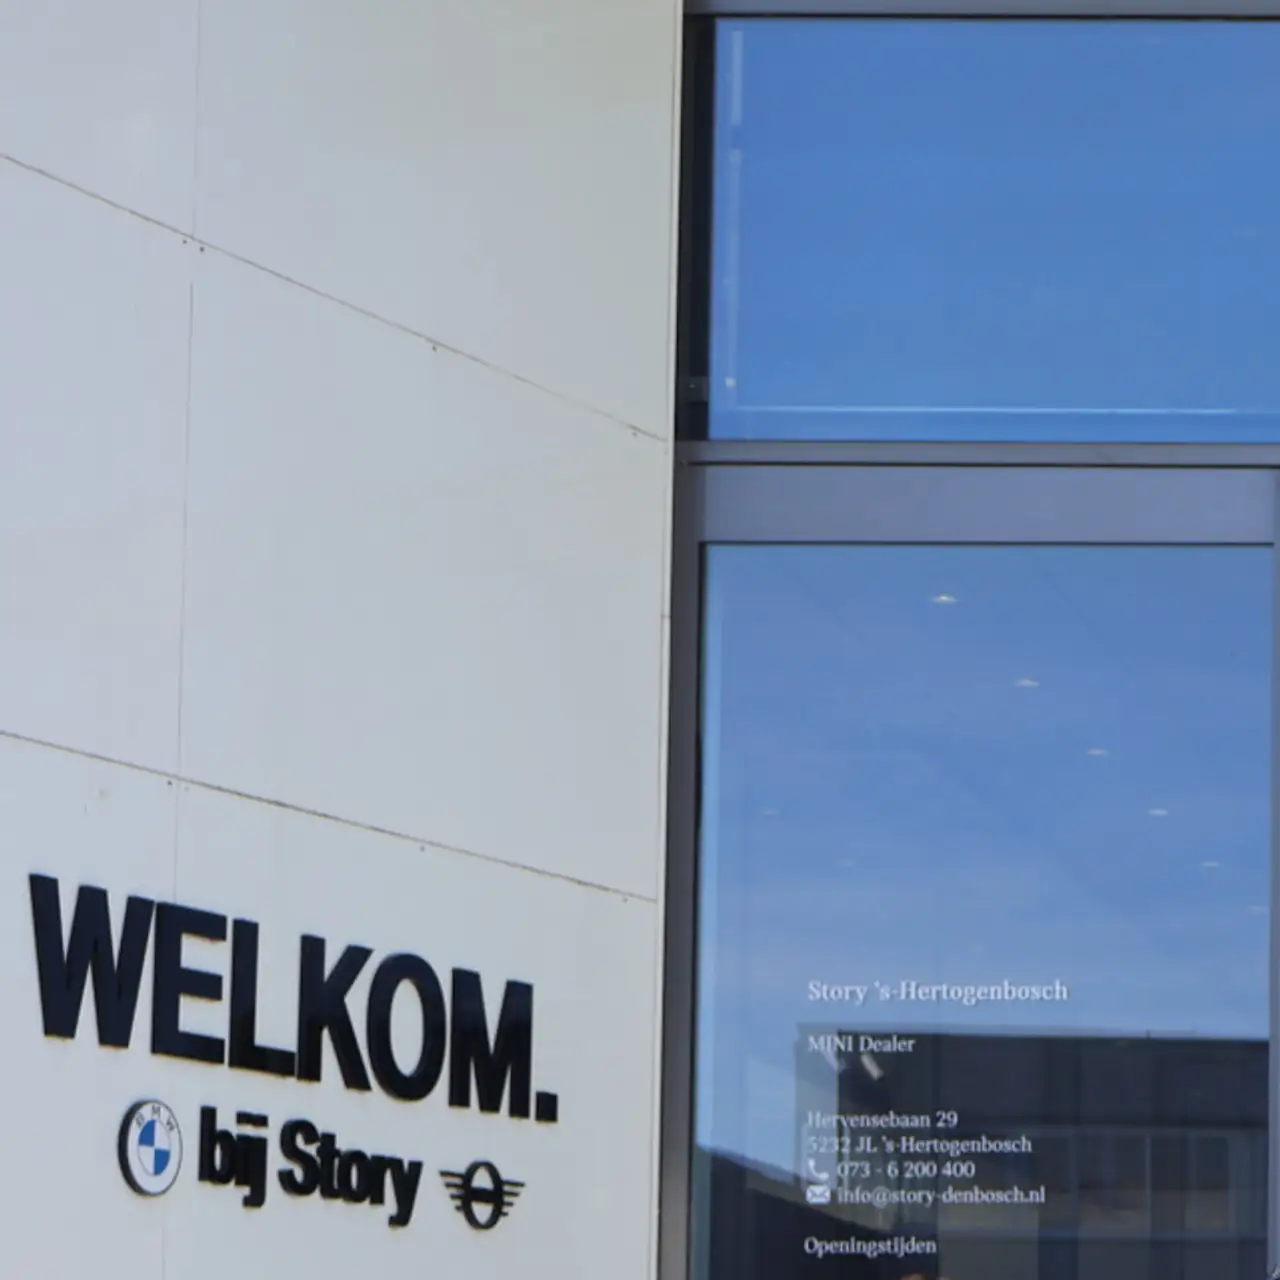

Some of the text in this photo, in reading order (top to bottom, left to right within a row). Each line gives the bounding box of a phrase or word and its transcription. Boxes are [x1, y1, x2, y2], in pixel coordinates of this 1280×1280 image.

[28, 872, 558, 1123] WELKOM.
[808, 979, 867, 1005] Story
[808, 1035, 915, 1052] MINI Dealer
[807, 1111, 958, 1128] Hervensebaan 29
[807, 1136, 850, 1153] 5232
[855, 1136, 877, 1153] JL
[198, 1105, 423, 1228] bij Story
[837, 1161, 871, 1178] 073
[887, 1161, 899, 1178] 6
[903, 1161, 937, 1178] 200
[941, 1161, 976, 1178] 400
[837, 1185, 1045, 1208] info@story-denbosch.nl
[804, 1237, 936, 1257] Openingstijden
